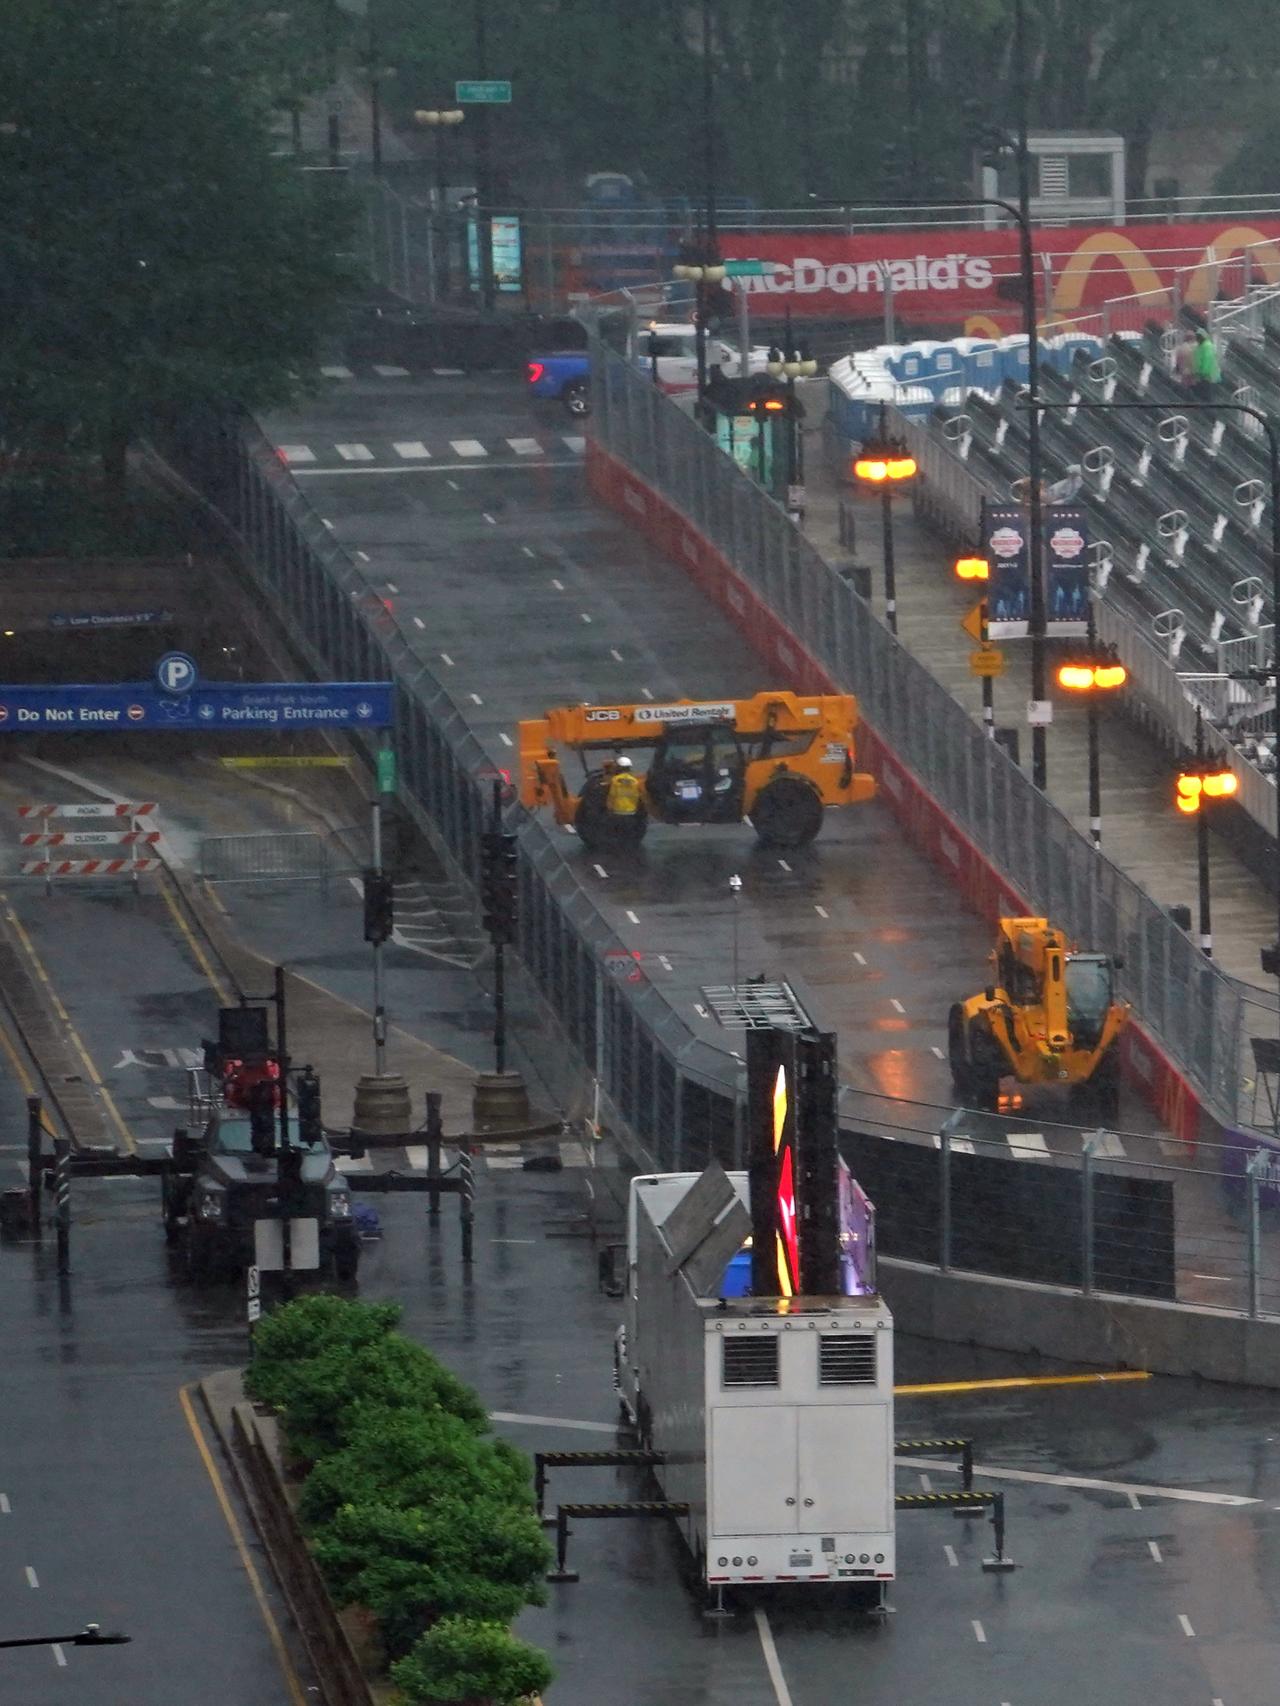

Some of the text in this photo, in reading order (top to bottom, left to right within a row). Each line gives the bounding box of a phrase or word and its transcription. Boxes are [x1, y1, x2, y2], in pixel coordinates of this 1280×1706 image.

[168, 662, 189, 687] P
[17, 708, 120, 721] Do Not Enter
[222, 706, 349, 722] Parking Entrance
[585, 710, 620, 721] JCB
[654, 706, 730, 718] United Rentals
